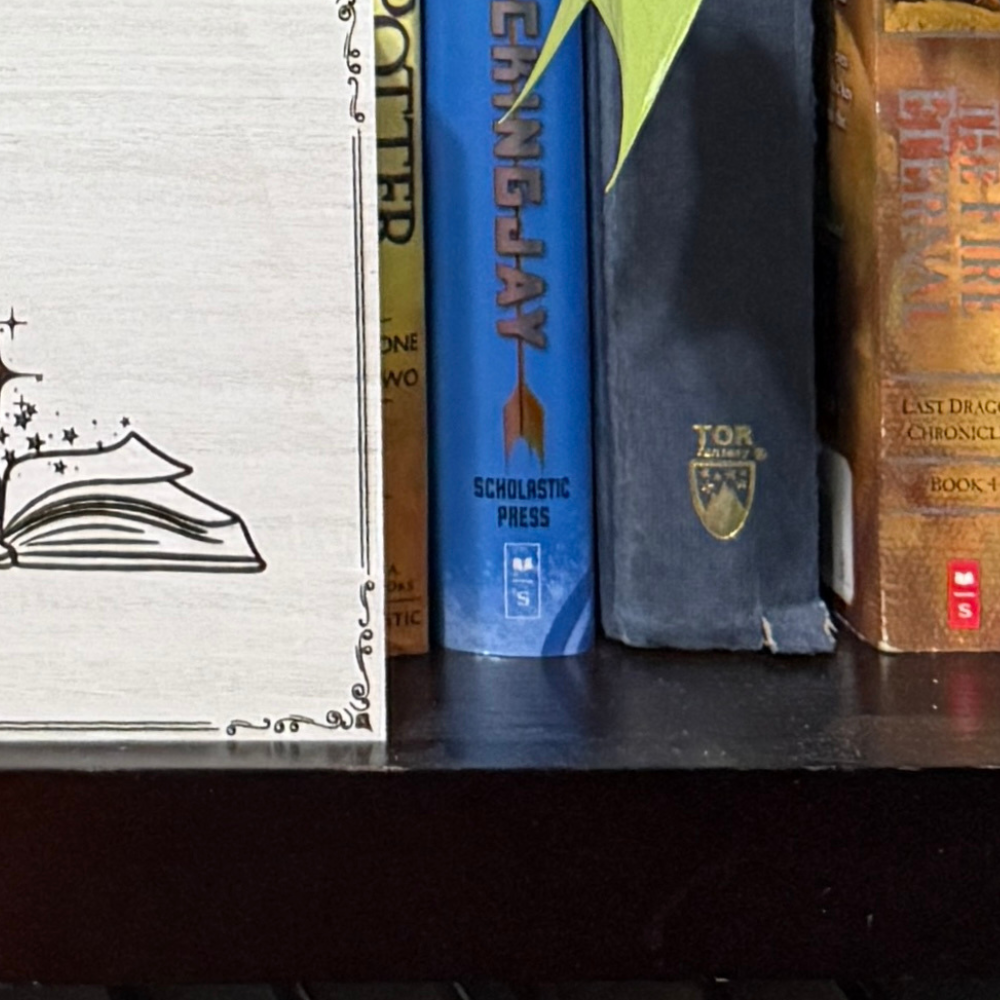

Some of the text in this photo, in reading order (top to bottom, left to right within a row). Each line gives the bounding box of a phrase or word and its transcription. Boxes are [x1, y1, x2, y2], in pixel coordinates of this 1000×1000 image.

[899, 86, 957, 326] ETERNAL
[382, 367, 419, 388] WO
[902, 398, 1000, 415] LAST DRAG
[692, 424, 753, 446] TOR
[473, 476, 571, 499] SCHOLASTIC
[931, 476, 983, 493] BOOK
[497, 506, 550, 528] PRESS
